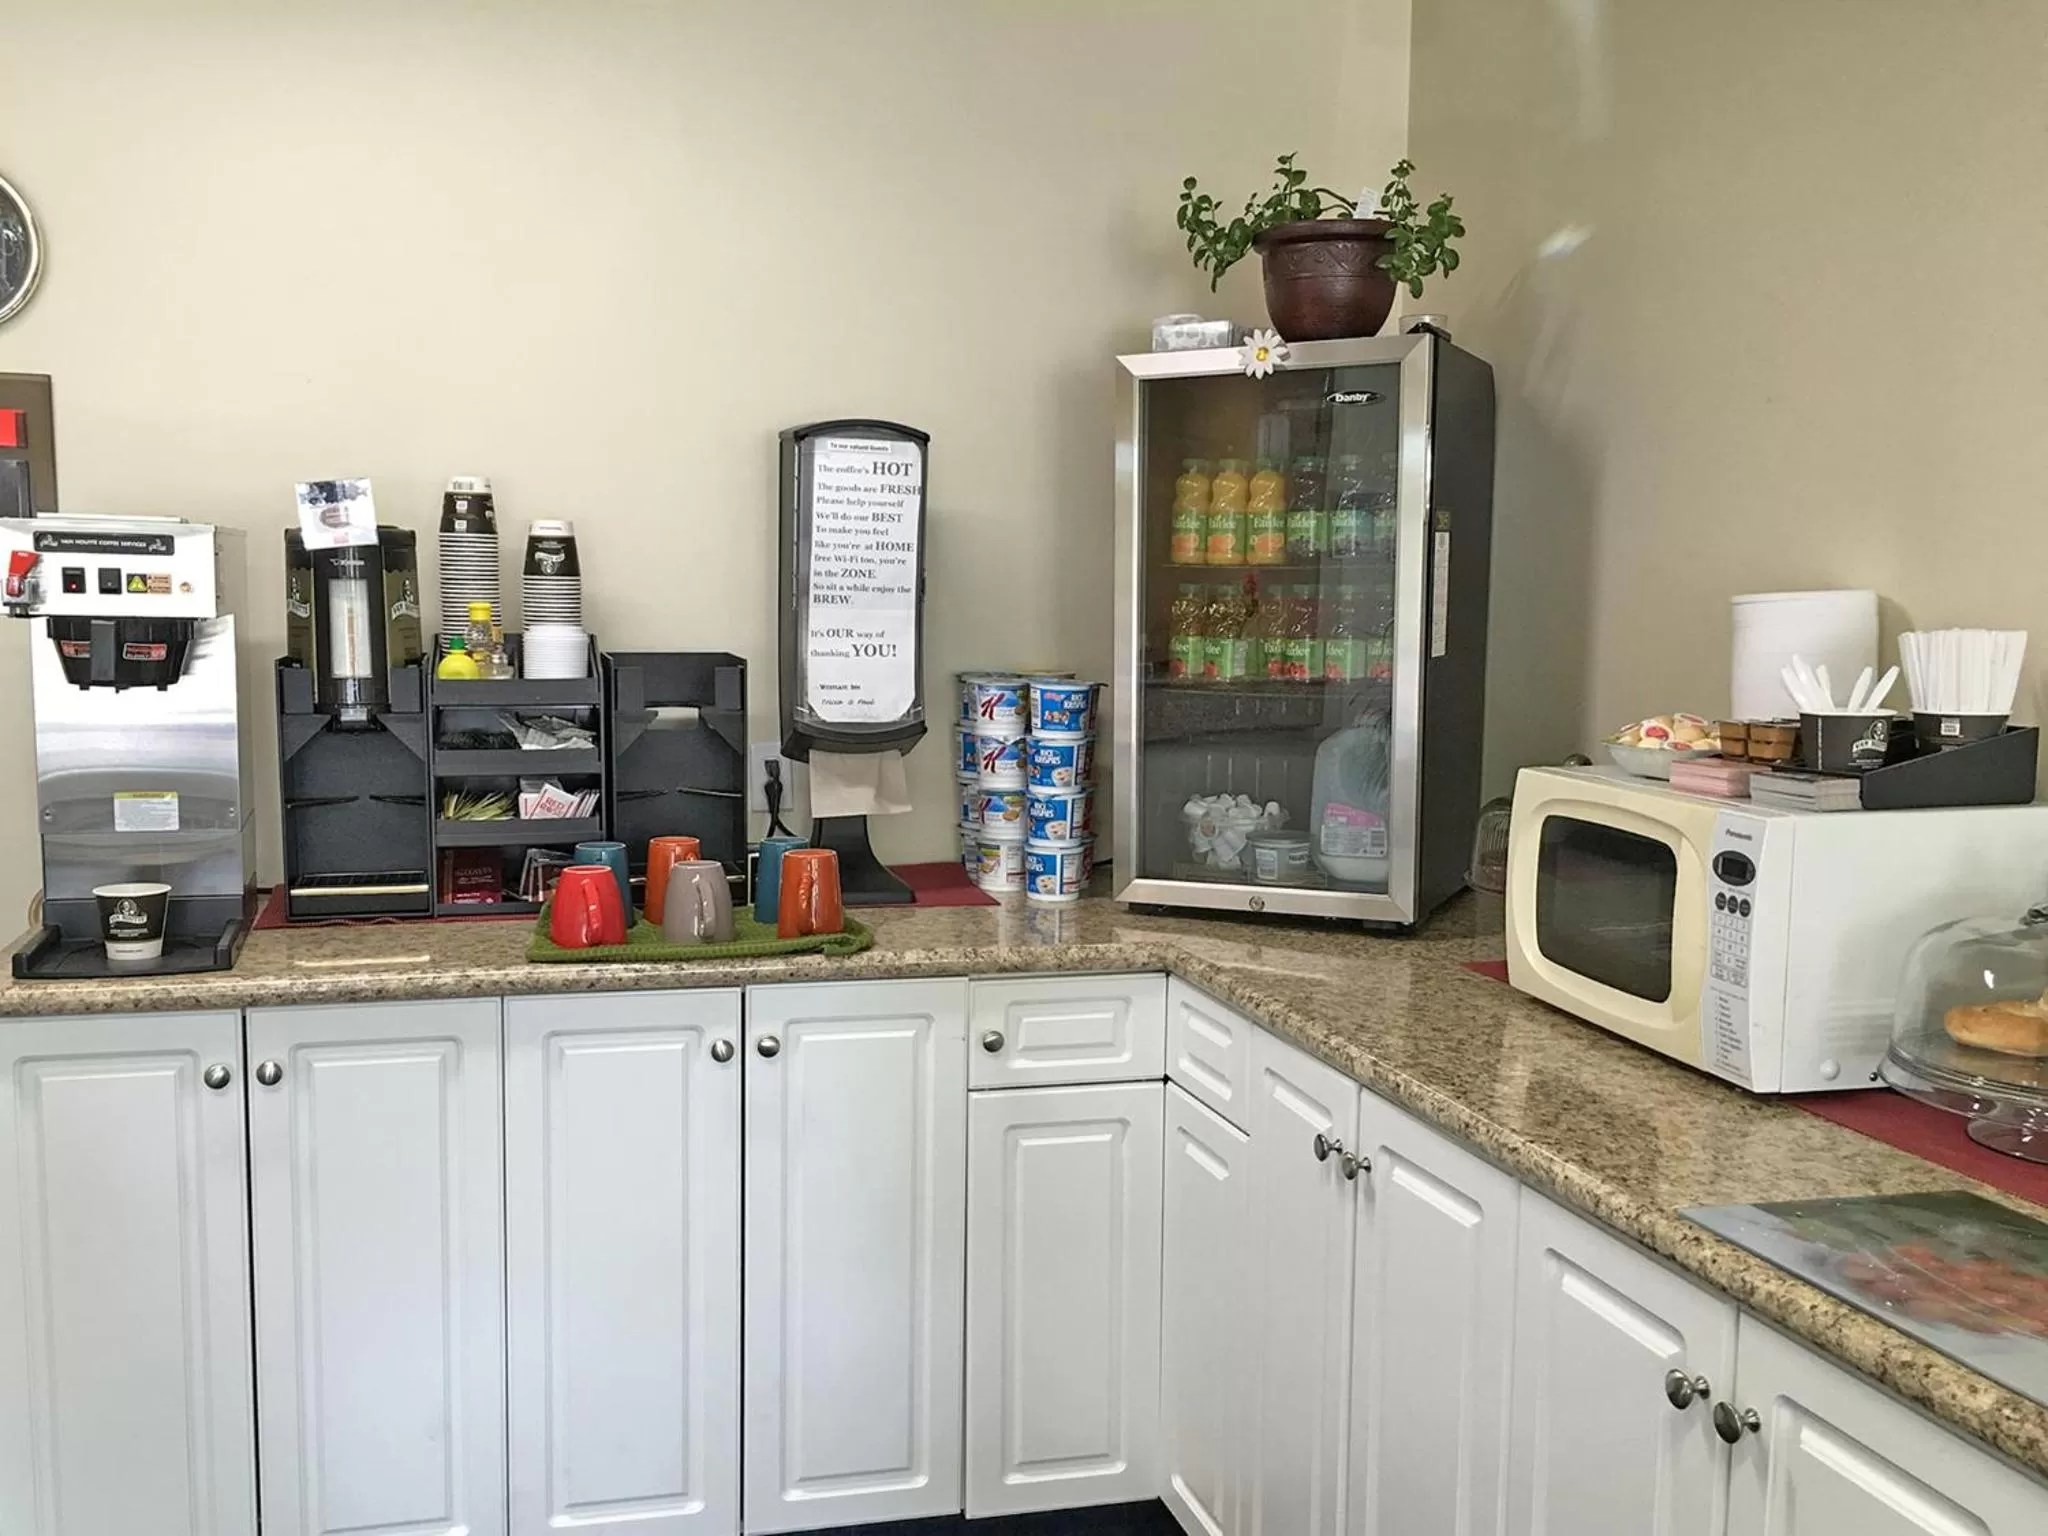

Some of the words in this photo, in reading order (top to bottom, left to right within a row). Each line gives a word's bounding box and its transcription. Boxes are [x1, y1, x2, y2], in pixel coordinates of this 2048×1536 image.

[1335, 393, 1371, 402] Danby
[818, 464, 833, 473] The
[872, 461, 913, 477] HOT
[818, 482, 833, 491] The
[835, 484, 862, 494] goods
[863, 486, 877, 494] are
[879, 484, 922, 496] FRESH
[816, 496, 844, 505] Please
[846, 498, 865, 508] help
[867, 499, 905, 509] yourself
[816, 512, 839, 520] We'll
[841, 512, 852, 521] do
[871, 512, 903, 523] BEST
[816, 525, 827, 533] To
[829, 526, 853, 534] make
[855, 527, 871, 536] you
[873, 527, 889, 536] feel
[815, 540, 831, 549] like
[833, 541, 860, 550] you're
[875, 541, 915, 553] HOME
[815, 554, 832, 563] free
[834, 555, 858, 564] Wi-Fi
[879, 556, 907, 566] you're
[814, 569, 823, 577] in
[824, 568, 839, 577] the
[814, 583, 824, 591] So
[826, 583, 838, 591] sit
[846, 584, 870, 593] while
[872, 586, 895, 595] enjoy
[897, 586, 912, 594] the
[811, 629, 825, 638] It's
[826, 628, 854, 638] OUR
[856, 633, 873, 641] way
[876, 630, 885, 638] of
[811, 649, 850, 658] thanking
[851, 643, 897, 657] YOU!
